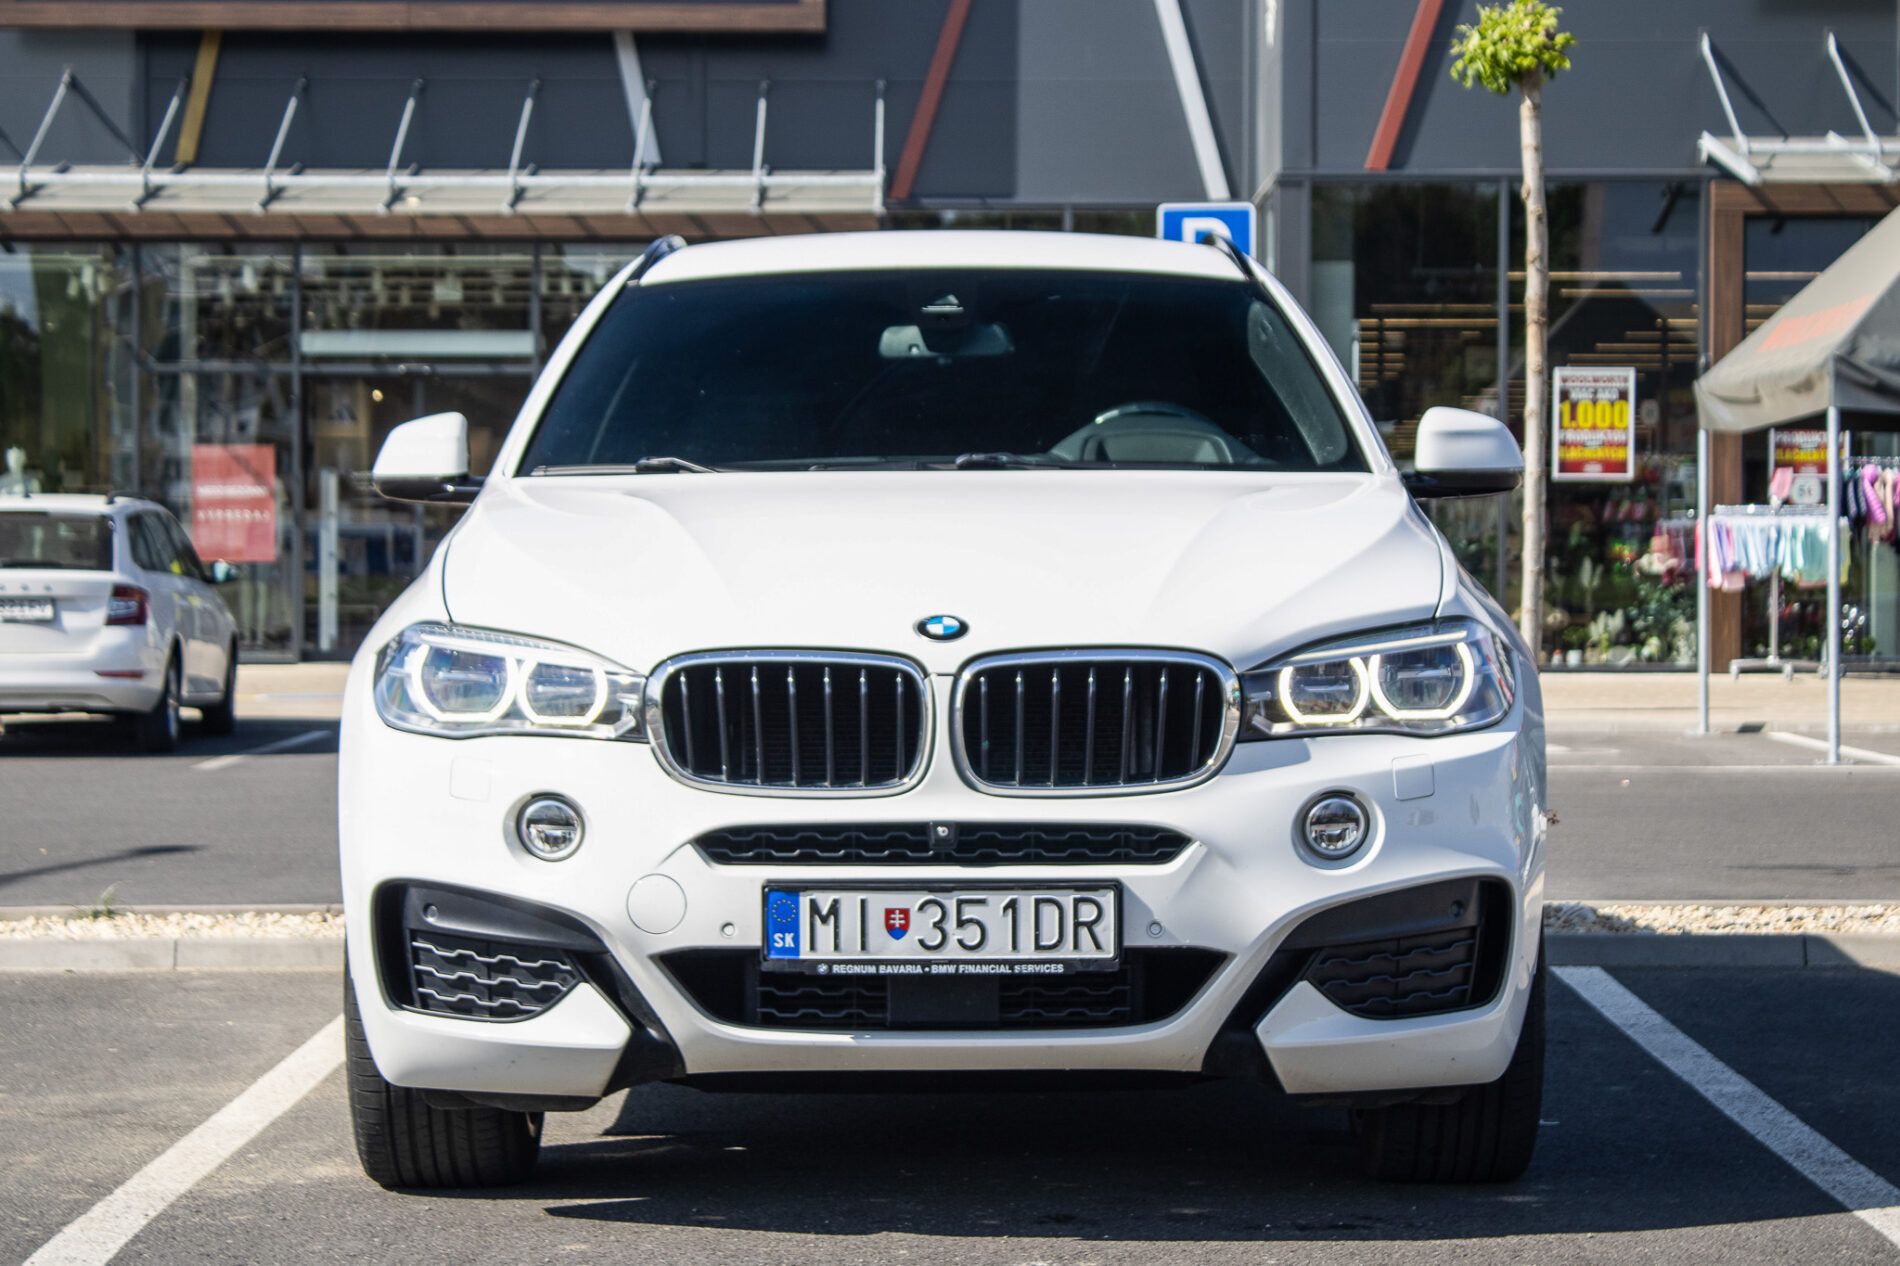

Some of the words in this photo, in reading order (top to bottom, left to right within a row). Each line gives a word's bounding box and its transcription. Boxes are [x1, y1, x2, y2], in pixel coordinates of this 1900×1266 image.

[1559, 399, 1629, 430] 1.000
[808, 896, 869, 952] MI
[915, 895, 1106, 952] 351DR
[773, 933, 796, 947] SK
[832, 964, 877, 974] REGNUM
[878, 964, 924, 974] BAVARIA
[930, 964, 957, 974] BMW
[958, 964, 1012, 974] FINANCIAL
[1013, 963, 1065, 974] SERVICES
